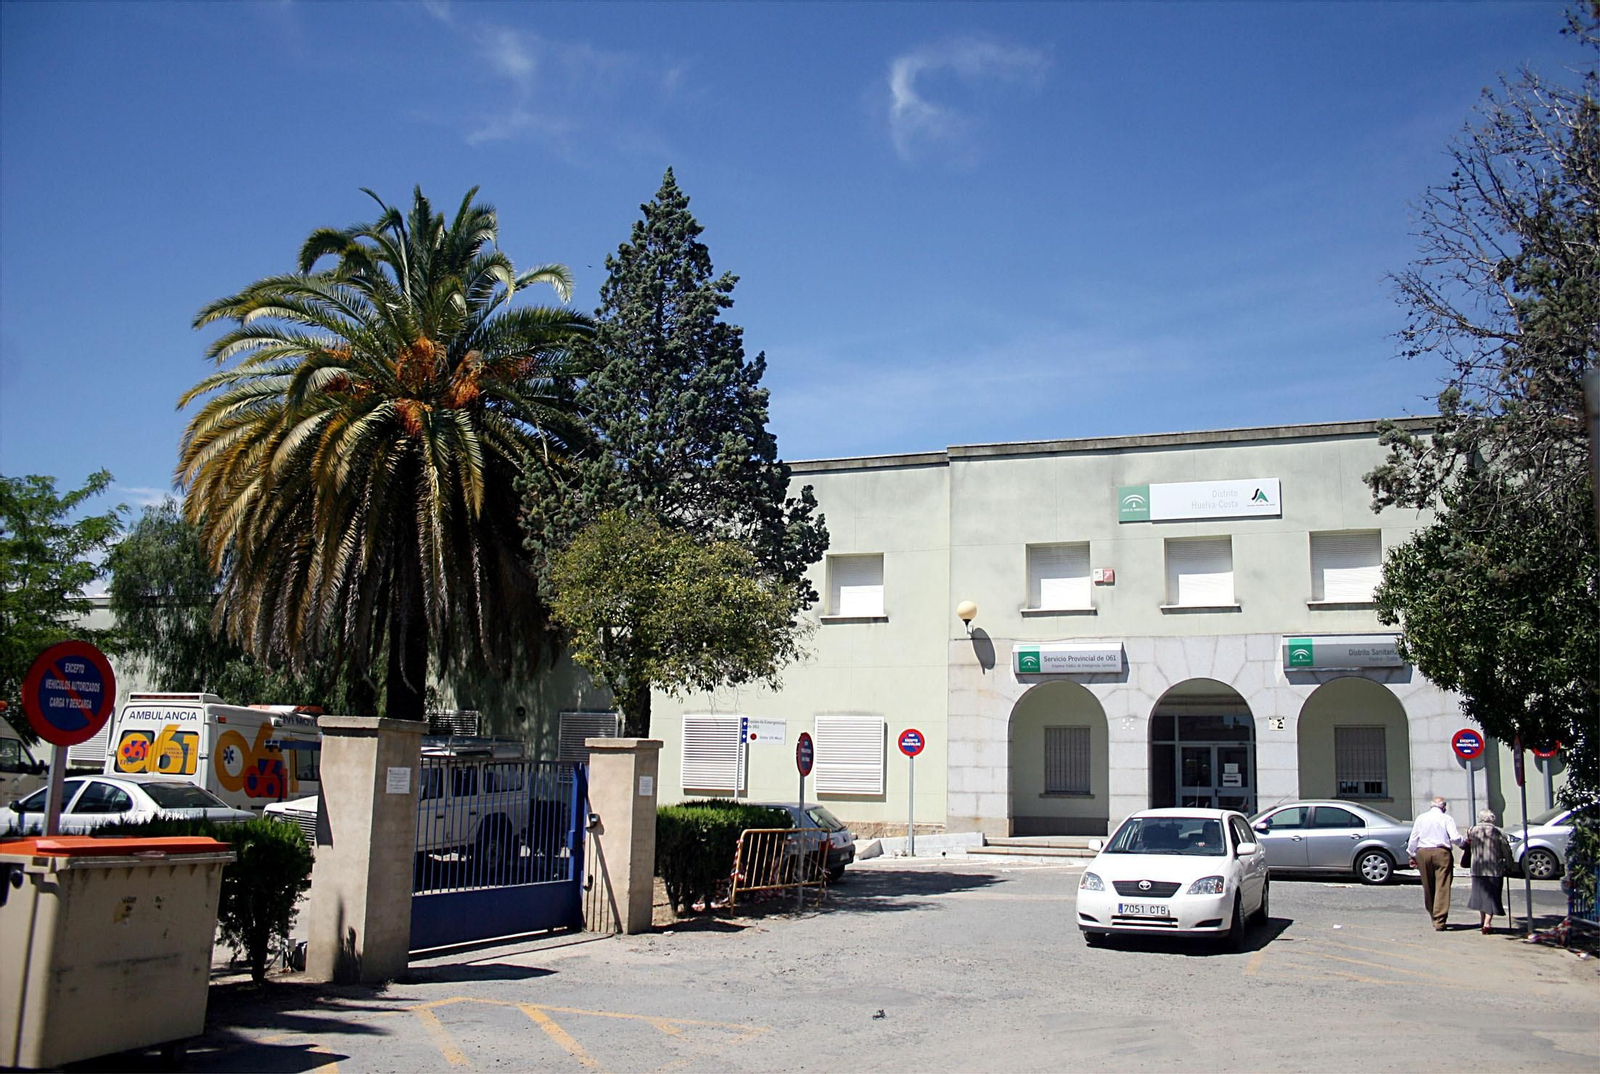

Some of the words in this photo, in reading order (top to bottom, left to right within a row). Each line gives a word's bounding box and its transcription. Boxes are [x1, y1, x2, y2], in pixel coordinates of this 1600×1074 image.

[1212, 489, 1238, 498] Distrito
[1191, 500, 1238, 510] Huelva-Costa
[1348, 648, 1371, 656] Distrito
[1043, 655, 1066, 663] Servicio
[1067, 654, 1096, 662] Provincial
[65, 662, 85, 674] EXCEPTO
[45, 678, 71, 690] VEHICULOS
[71, 681, 101, 693] AUTORIZADOS
[49, 697, 65, 708] CARGA
[65, 698, 70, 708] Y
[69, 698, 92, 709] DESCARGA
[128, 710, 197, 721] AMBULANCIA
[1124, 904, 1145, 914] 7051
[1149, 904, 1167, 915] CTB
